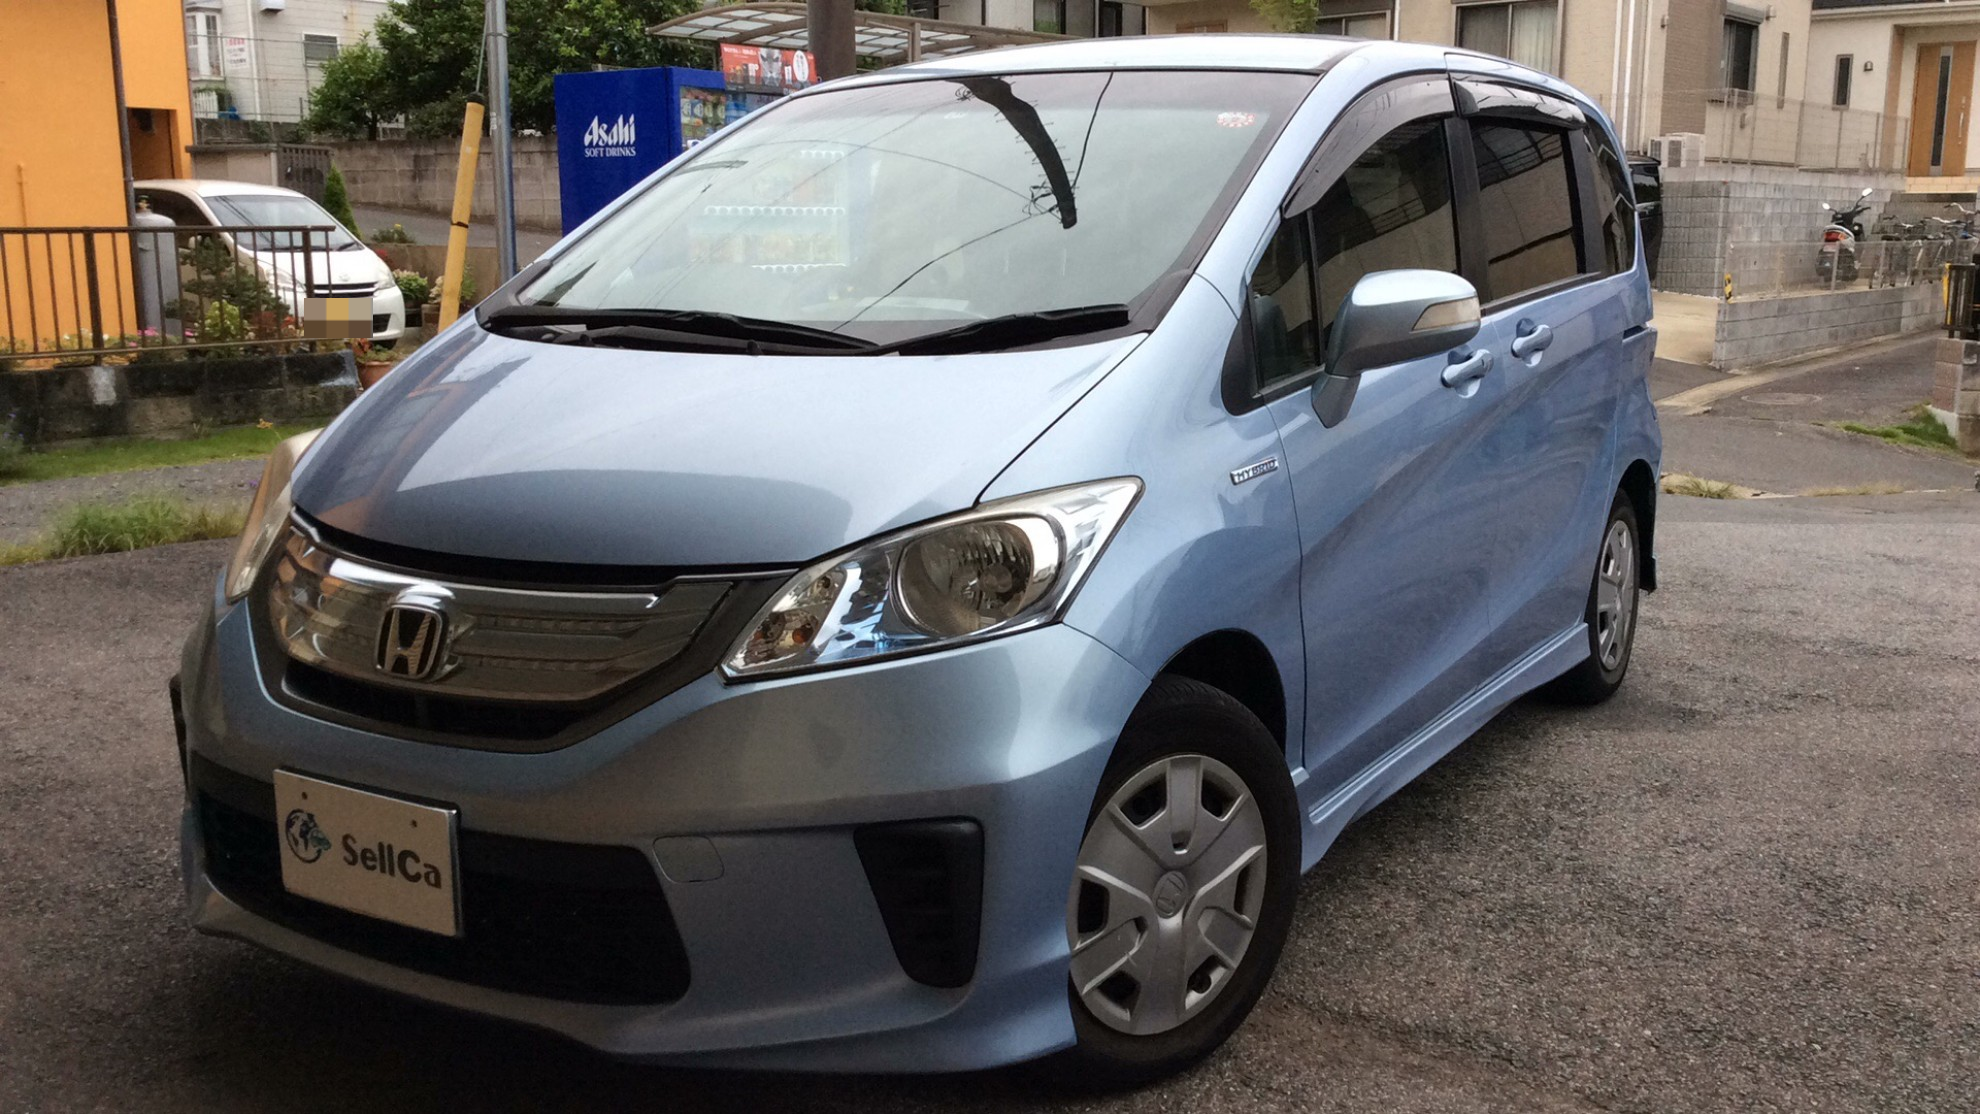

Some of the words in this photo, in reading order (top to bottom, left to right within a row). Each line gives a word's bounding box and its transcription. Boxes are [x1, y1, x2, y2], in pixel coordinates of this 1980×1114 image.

[584, 113, 636, 147] Asahi
[584, 147, 604, 157] SOFT
[605, 146, 637, 157] DRINKS
[1235, 459, 1276, 482] HYBRID
[341, 833, 442, 890] SellCa
